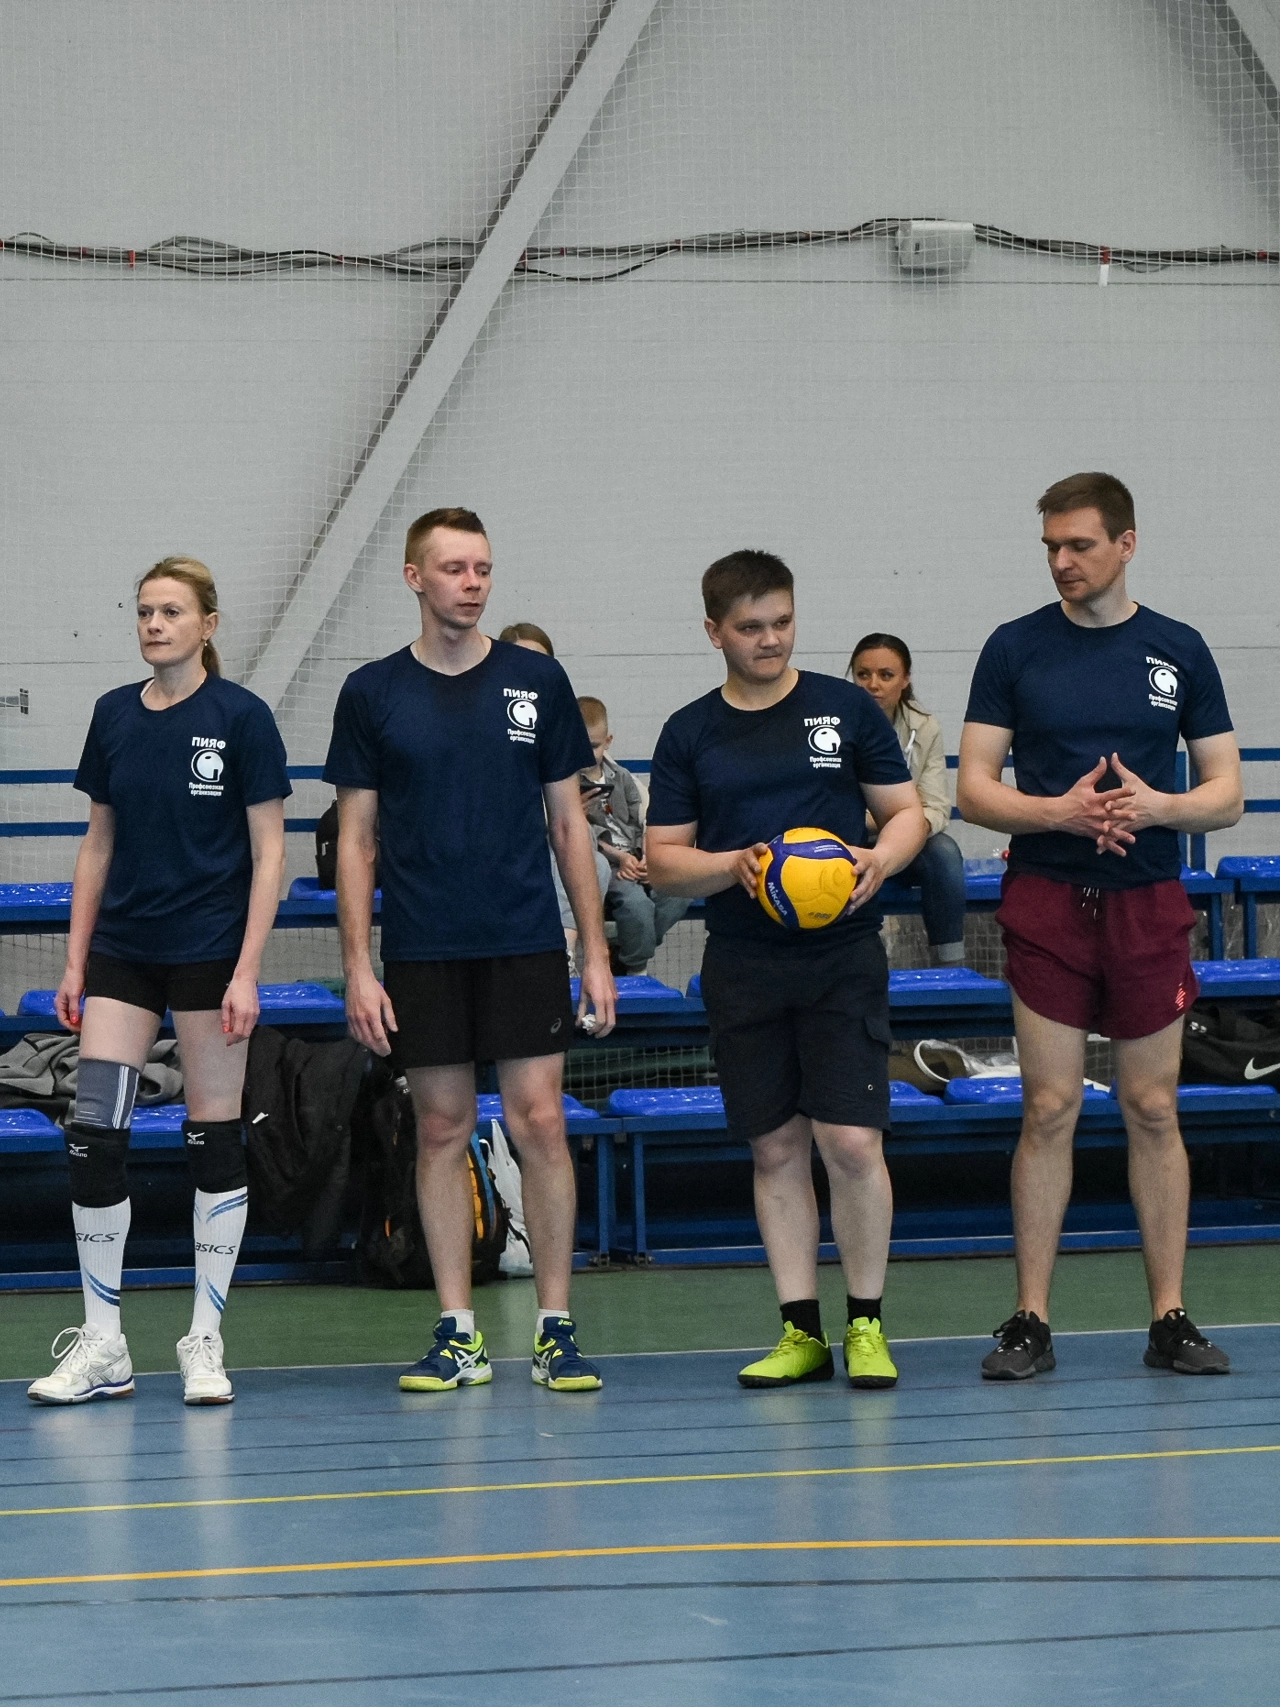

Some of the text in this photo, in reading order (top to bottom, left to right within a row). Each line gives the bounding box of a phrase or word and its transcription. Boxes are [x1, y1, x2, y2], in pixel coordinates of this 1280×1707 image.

[503, 688, 538, 700] ПИЯФ
[804, 716, 840, 726] ПИЯФ
[192, 736, 226, 749] ПИЯФ
